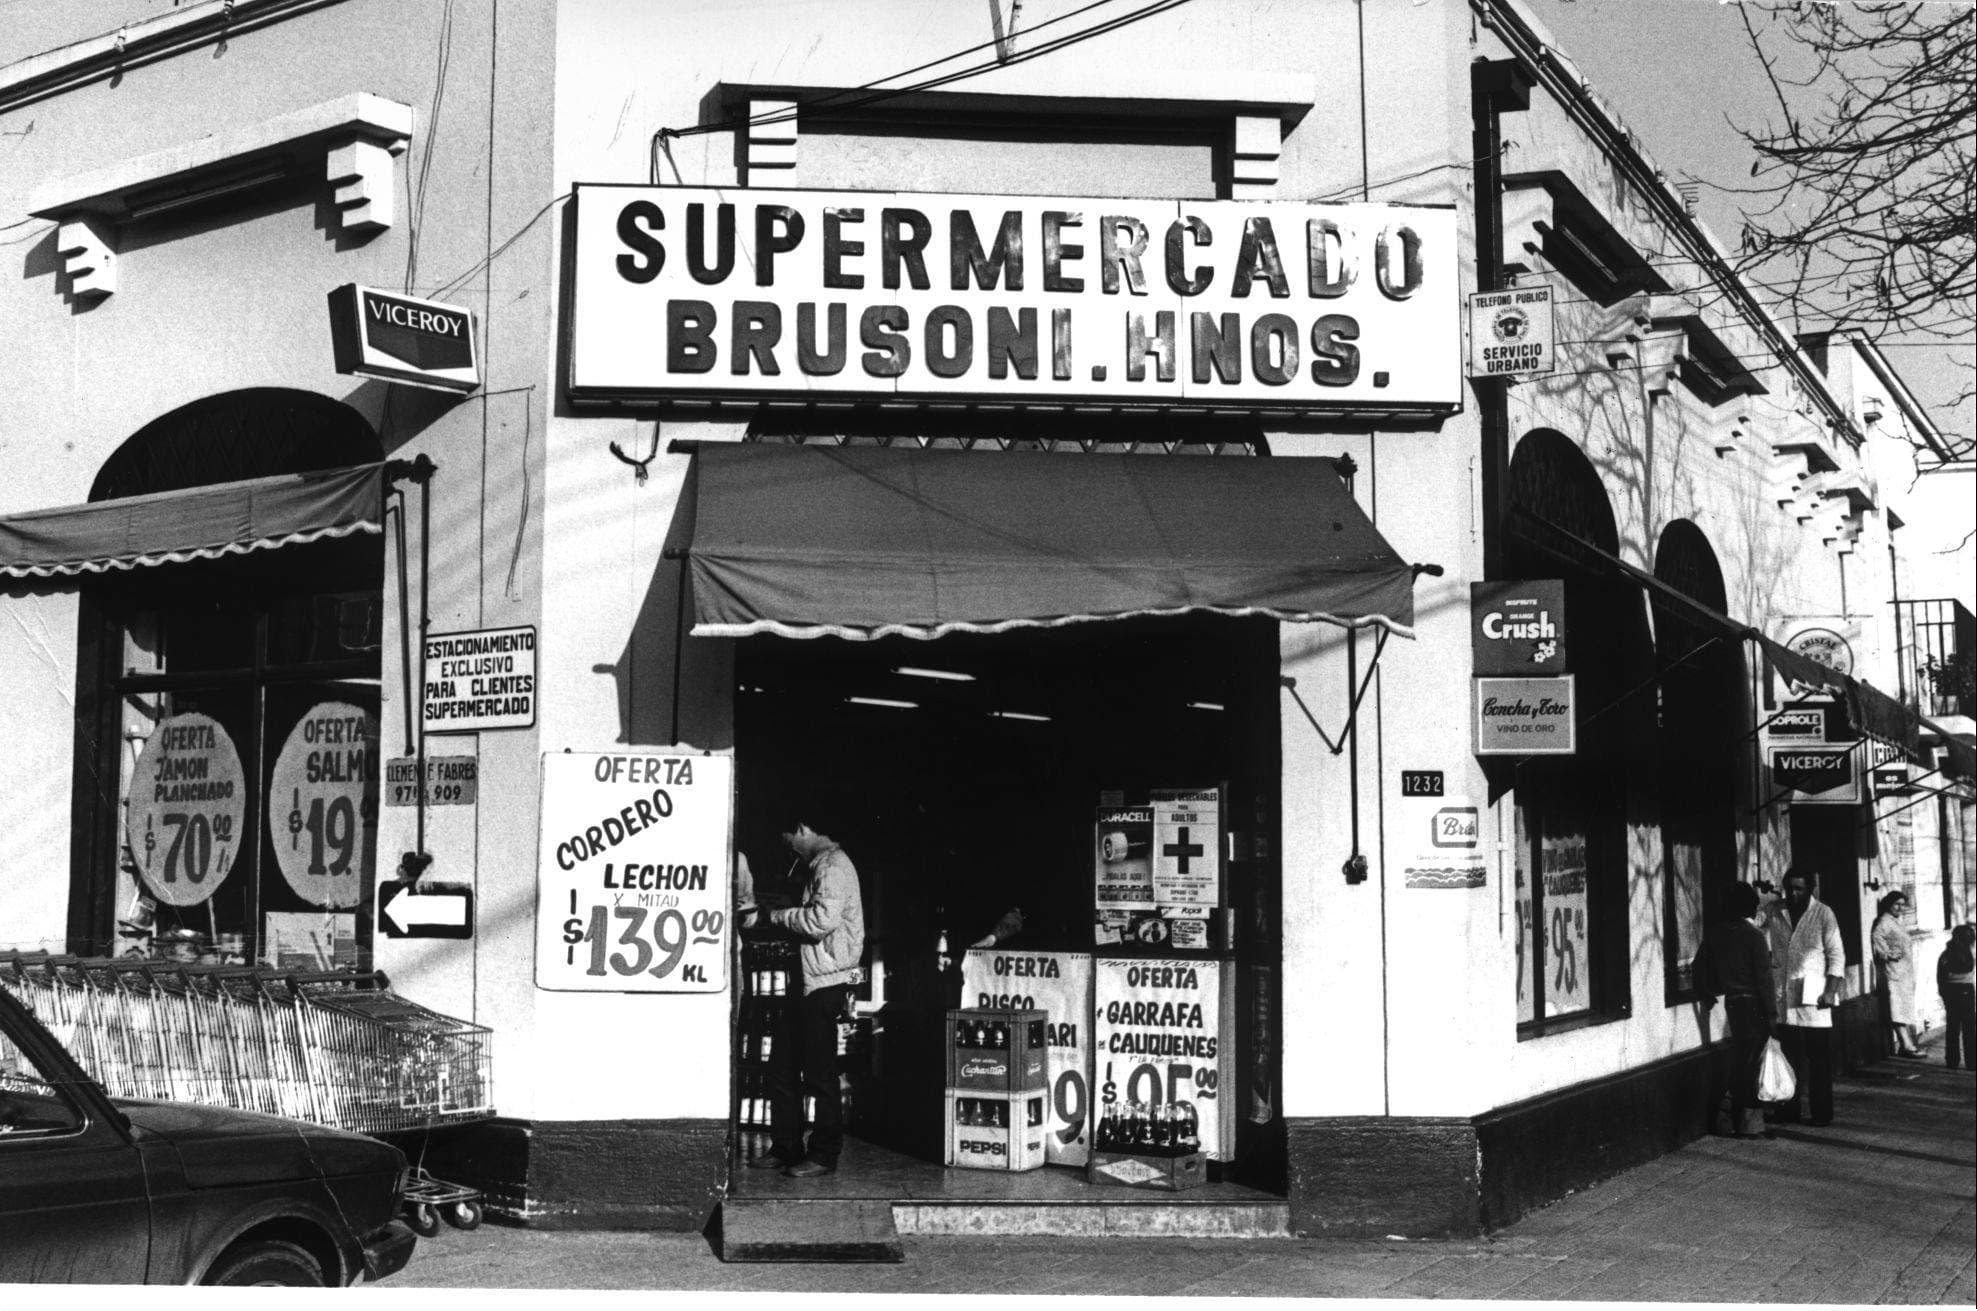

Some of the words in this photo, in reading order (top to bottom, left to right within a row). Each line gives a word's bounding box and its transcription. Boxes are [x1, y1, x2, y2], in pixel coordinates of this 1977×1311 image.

[616, 200, 1423, 302] SUPERMERCADO
[1475, 294, 1512, 308] TELEFONO
[1515, 291, 1548, 304] PUBLICO
[369, 299, 463, 338] VICEROY
[1126, 310, 1390, 389] HNOS.
[1483, 343, 1542, 360] SERVICIO
[1487, 357, 1539, 373] URBANO
[1482, 610, 1556, 640] Crush
[425, 632, 534, 659] ESTACIONAMIENTO
[1799, 637, 1837, 650] CRISTAL
[441, 655, 513, 678] EXCLUSIVO
[425, 681, 457, 699] PARA
[471, 674, 533, 697] CLIENTES
[425, 696, 530, 720] SUPERMERCADO
[1483, 697, 1530, 716] Concha
[1532, 706, 1539, 719] y
[1539, 698, 1569, 716] Toro
[161, 725, 216, 750] OFERTA
[303, 716, 365, 744] OFERTA
[1497, 724, 1520, 734] VINO
[1521, 724, 1534, 733] DE
[1534, 724, 1556, 733] ORO
[154, 757, 209, 782] JAMON
[437, 762, 476, 781] FABRES
[594, 755, 694, 785] OFERTA
[1780, 756, 1844, 769] VICEROY
[154, 780, 234, 803] PLANCHADO
[434, 784, 462, 801] 909
[1405, 775, 1441, 793] 1232
[556, 788, 674, 871] CORDERO
[603, 863, 709, 890] LECHON
[637, 893, 680, 908] MITAD
[682, 963, 708, 983] KL
[993, 955, 1061, 979] OFERTA
[1127, 966, 1199, 990] OFERTA
[1106, 1000, 1204, 1028] GARRAFA
[1109, 1032, 1218, 1059] CAUQUENES
[960, 1140, 1007, 1156] PEPSI
